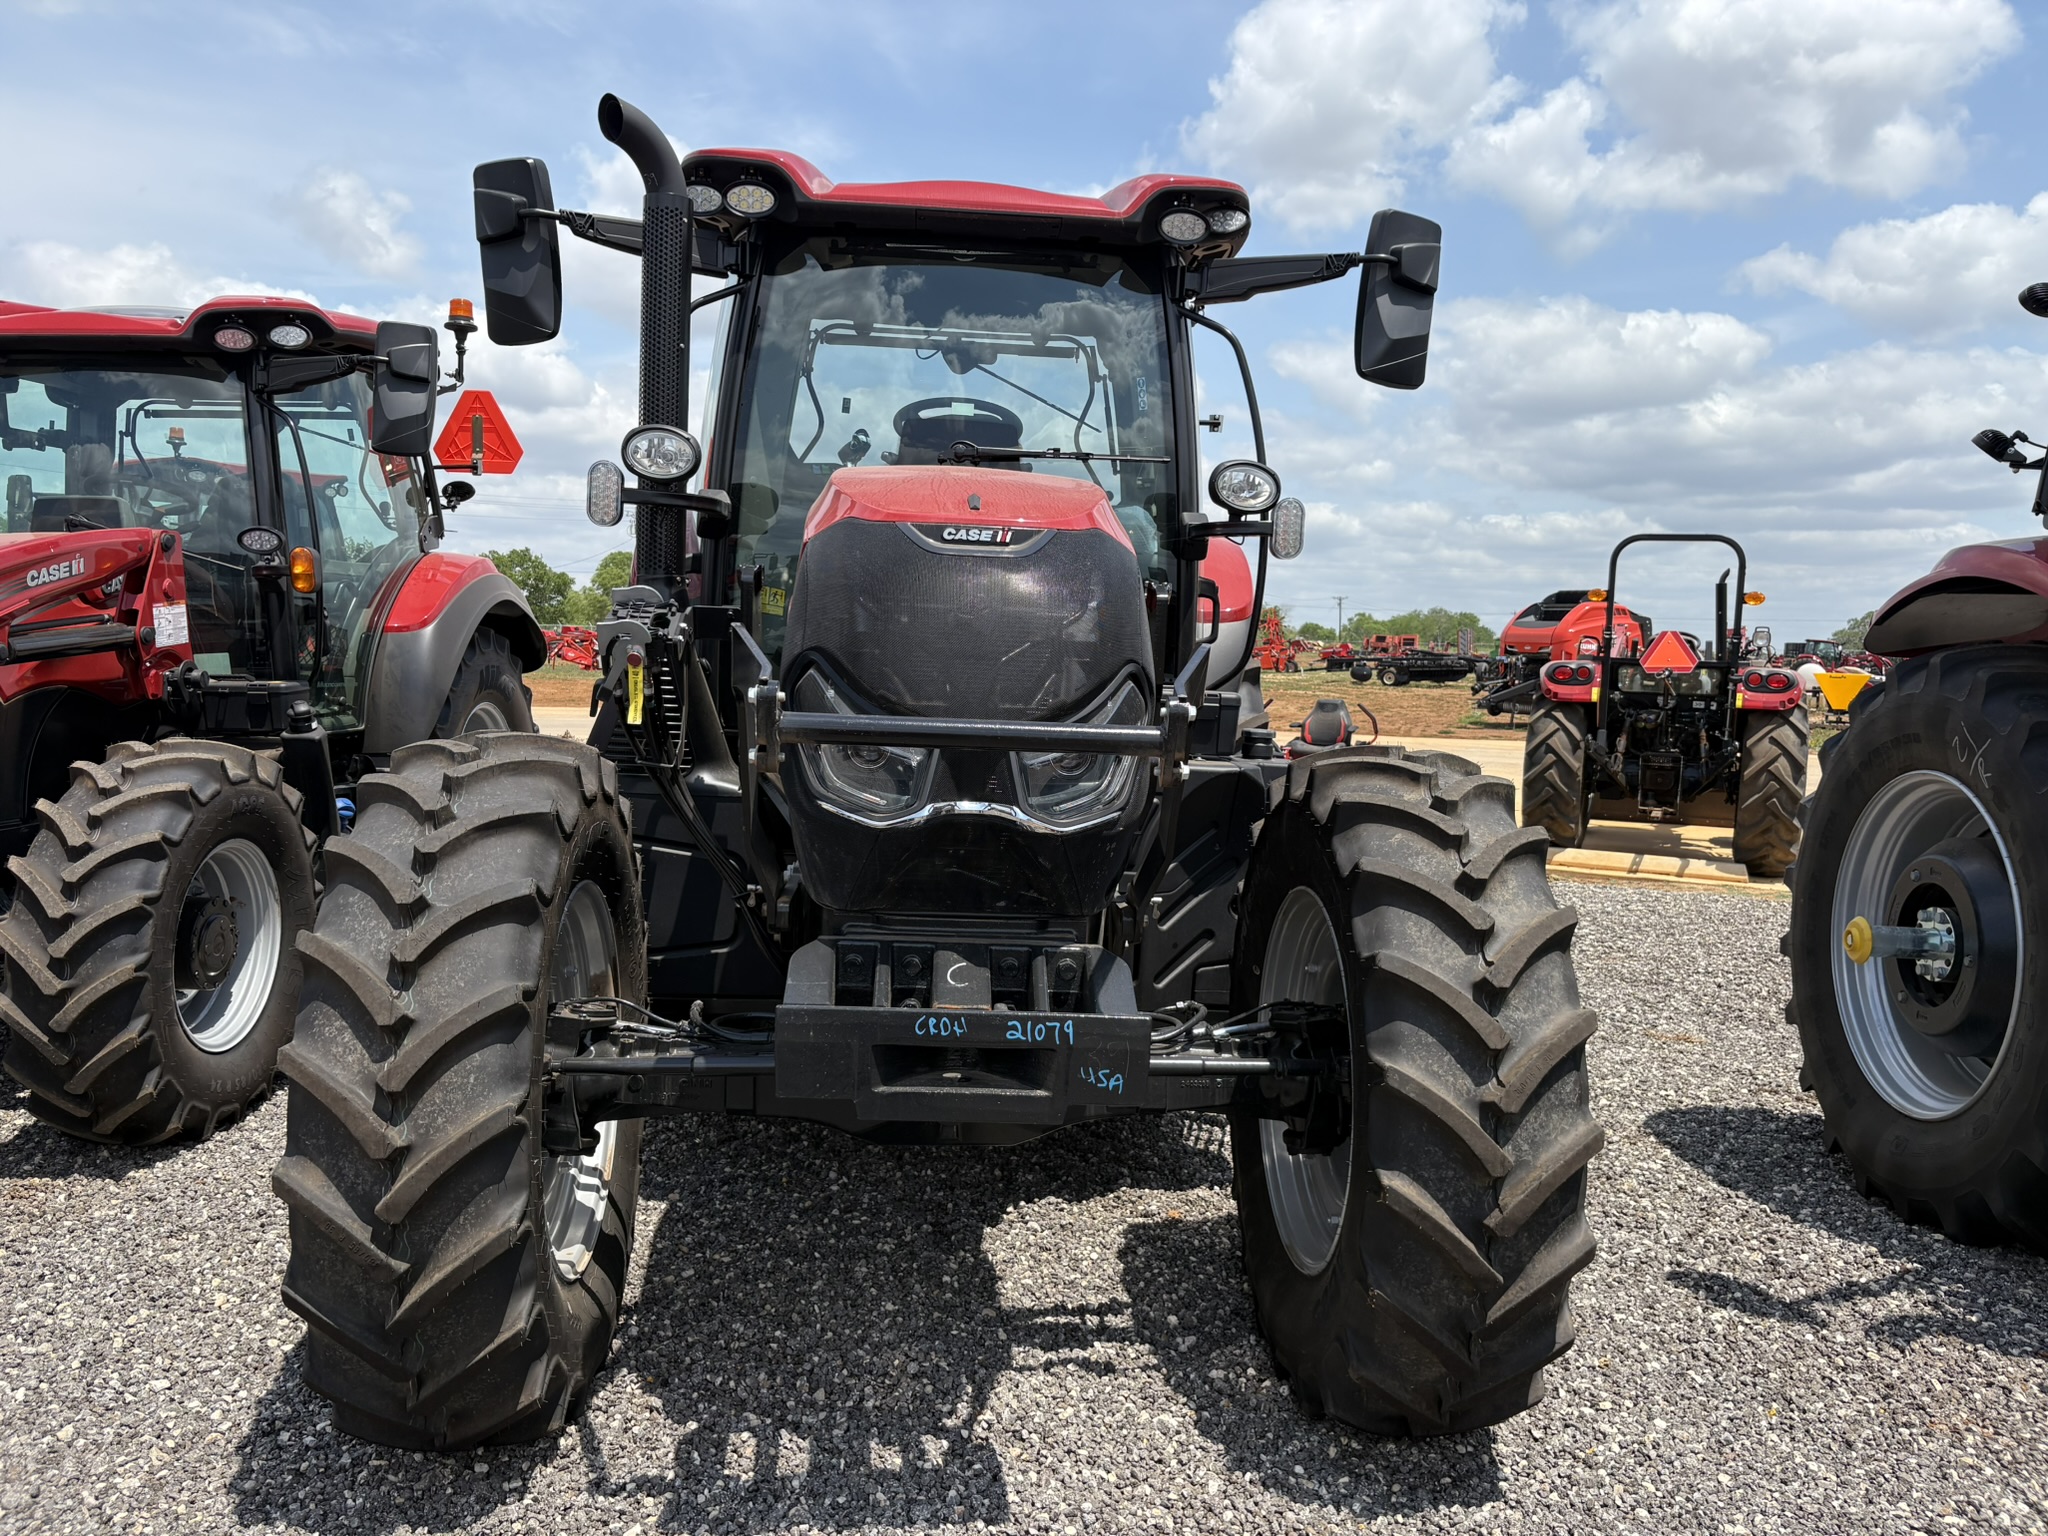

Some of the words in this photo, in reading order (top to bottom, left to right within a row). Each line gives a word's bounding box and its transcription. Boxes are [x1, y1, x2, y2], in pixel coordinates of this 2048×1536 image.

[943, 527, 993, 542] CASE
[27, 562, 70, 587] CASE
[947, 963, 969, 987] C
[1006, 1020, 1075, 1045] 21079
